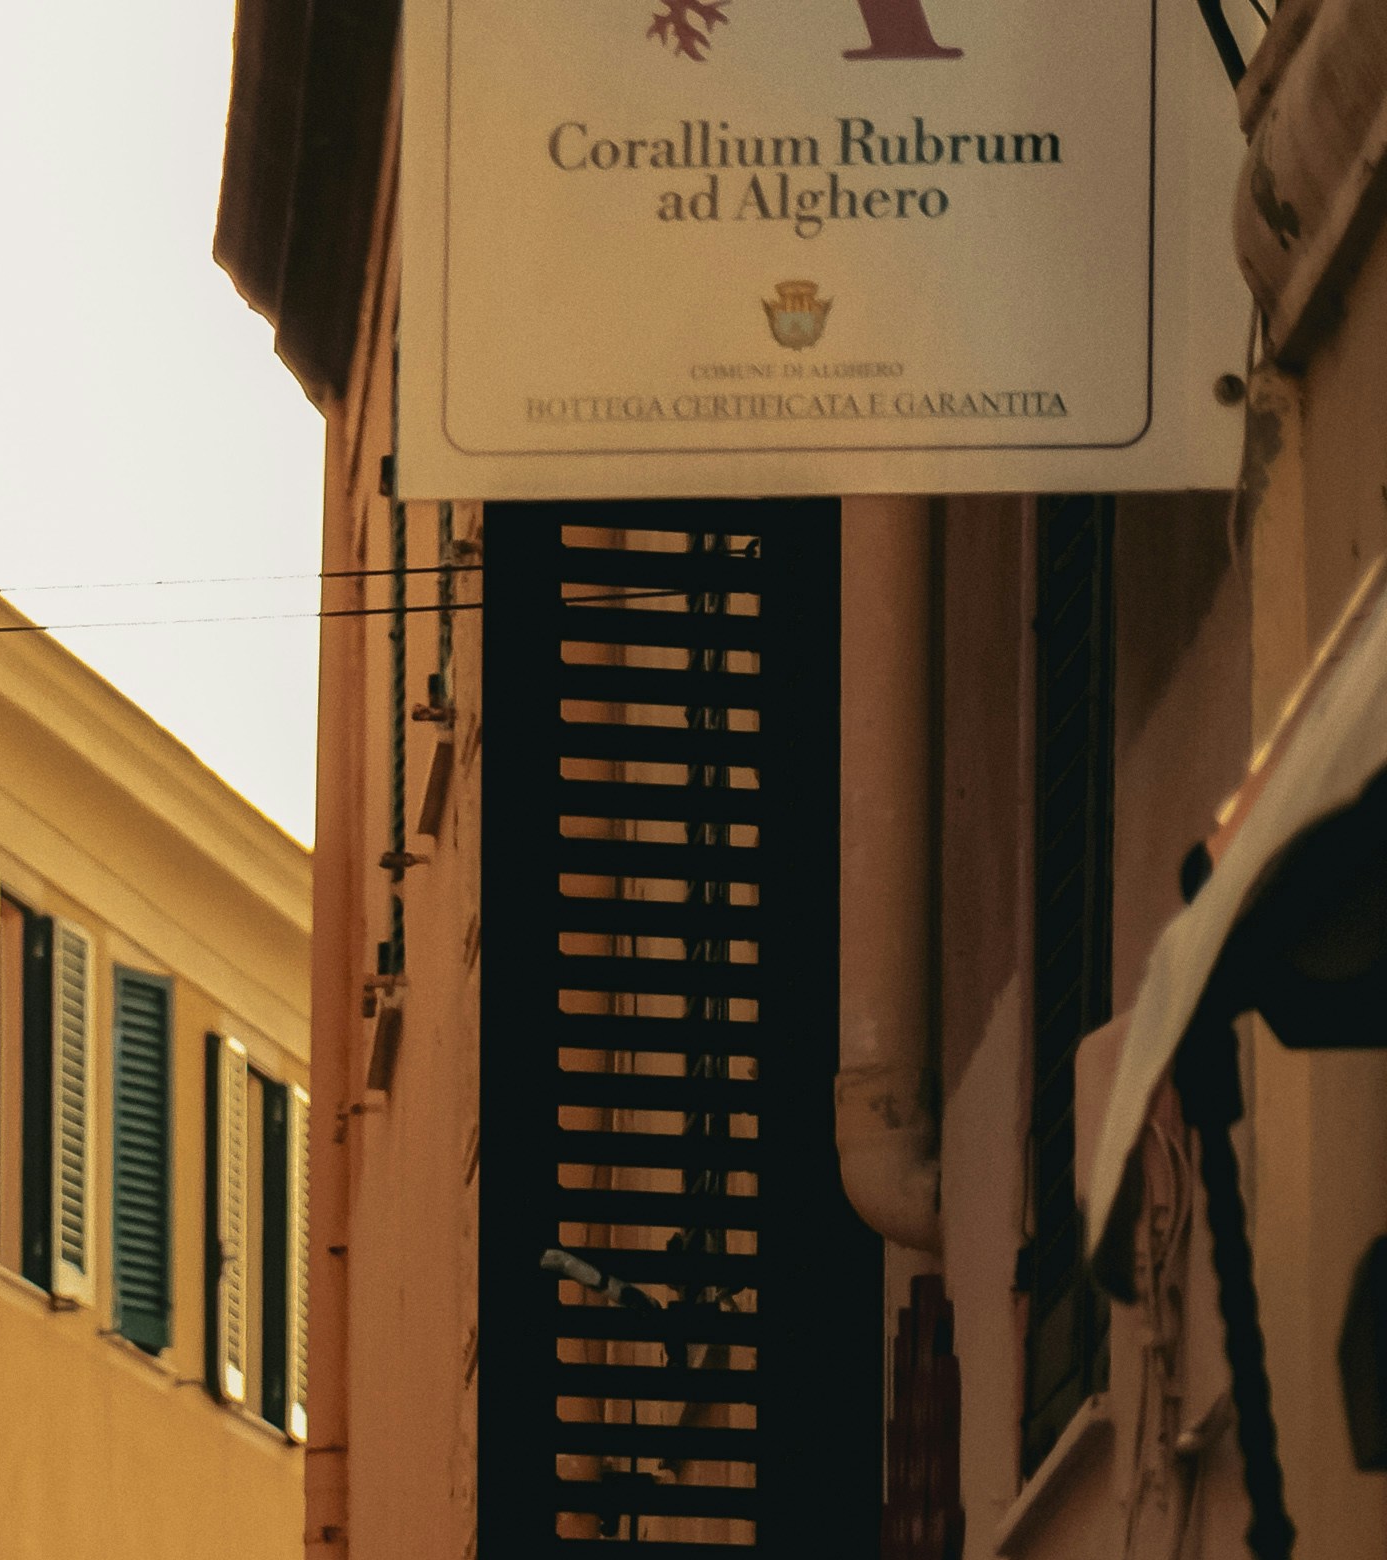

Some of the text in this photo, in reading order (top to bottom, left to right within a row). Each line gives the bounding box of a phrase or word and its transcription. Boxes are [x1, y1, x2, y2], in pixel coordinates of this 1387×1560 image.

[547, 117, 1062, 171] Corallium Rubrum
[656, 172, 950, 240] ad Alghero
[690, 361, 904, 380] COMUNE DI ALGHERO
[527, 390, 1068, 420] BOTTEGA CERTIFICATA E GARANTITA
